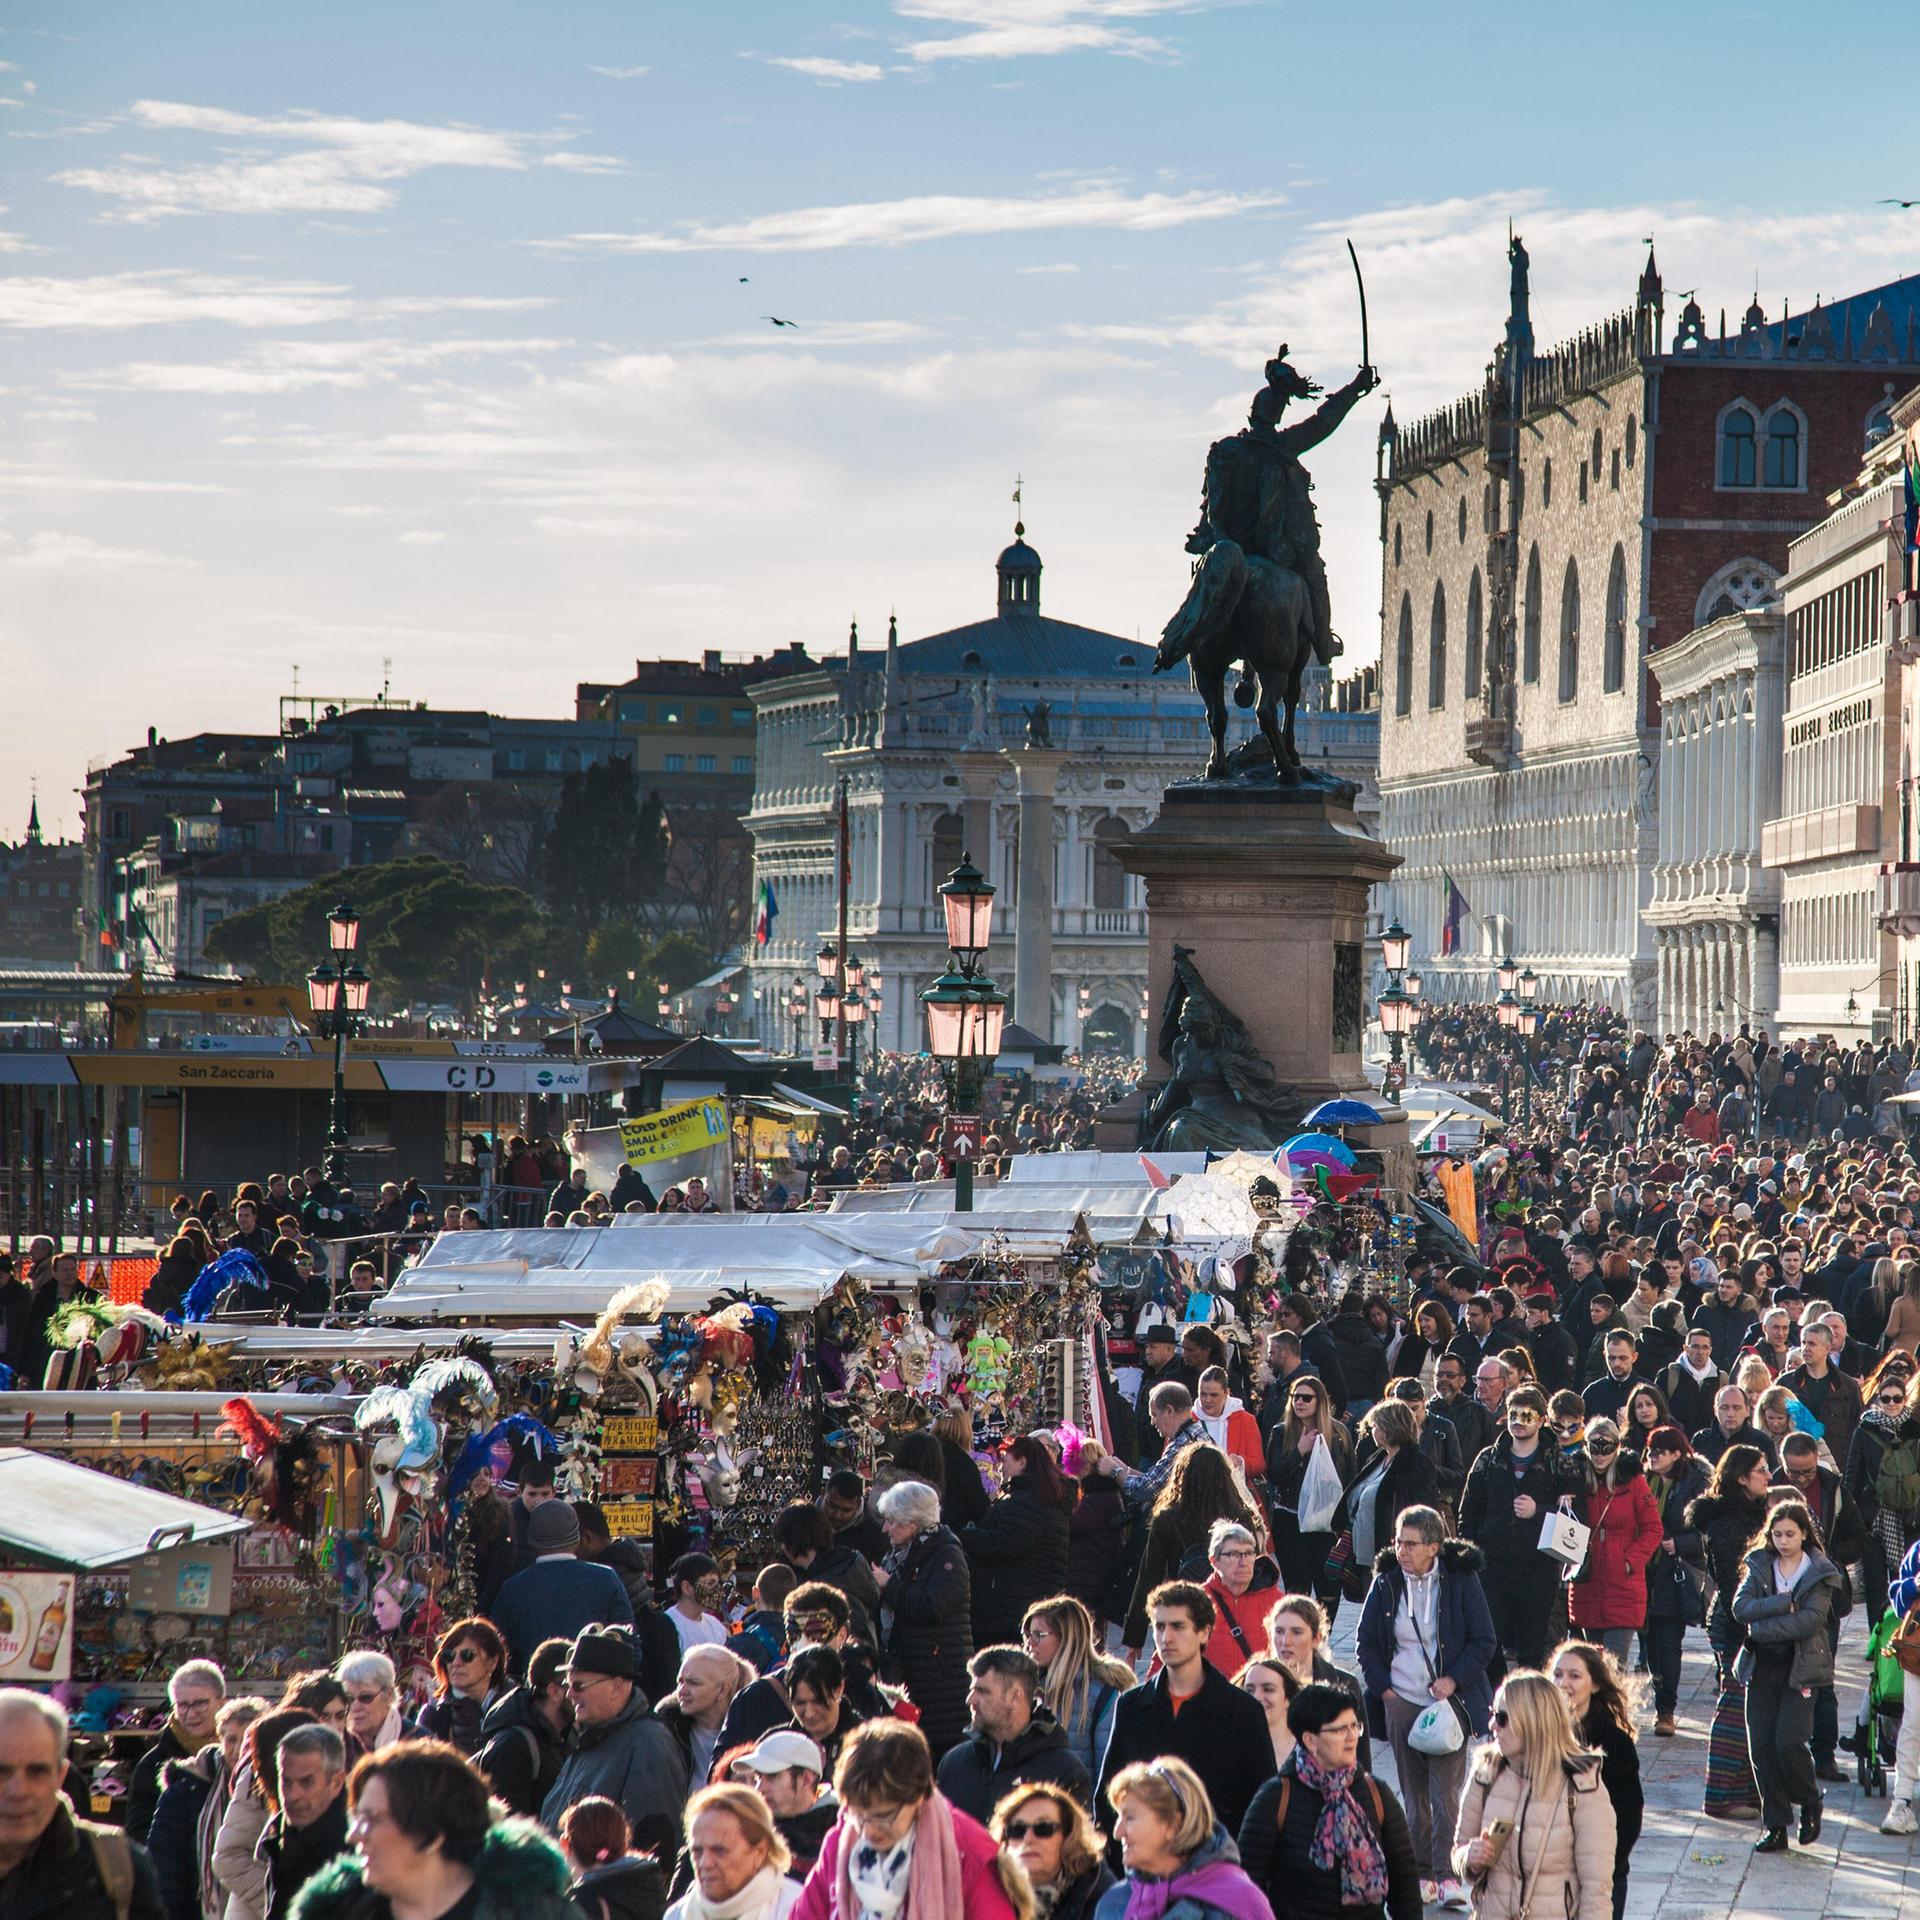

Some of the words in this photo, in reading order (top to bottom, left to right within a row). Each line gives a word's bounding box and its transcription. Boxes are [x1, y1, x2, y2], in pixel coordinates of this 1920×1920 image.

[352, 1043, 371, 1051] San
[372, 1043, 413, 1052] Zaccaria
[179, 1065, 207, 1078] San
[210, 1065, 275, 1079] Zaccaria
[447, 1066, 466, 1088] C
[476, 1066, 496, 1088] D
[557, 1074, 579, 1085] Actv
[623, 1121, 657, 1136] COLD
[659, 1106, 701, 1128] DRINK
[625, 1134, 659, 1147] SMALL
[627, 1147, 646, 1159] BIG
[608, 1421, 624, 1432] PER
[625, 1420, 653, 1432] RIALTO
[603, 1435, 619, 1446] PER
[621, 1513, 650, 1524] RIALTO
